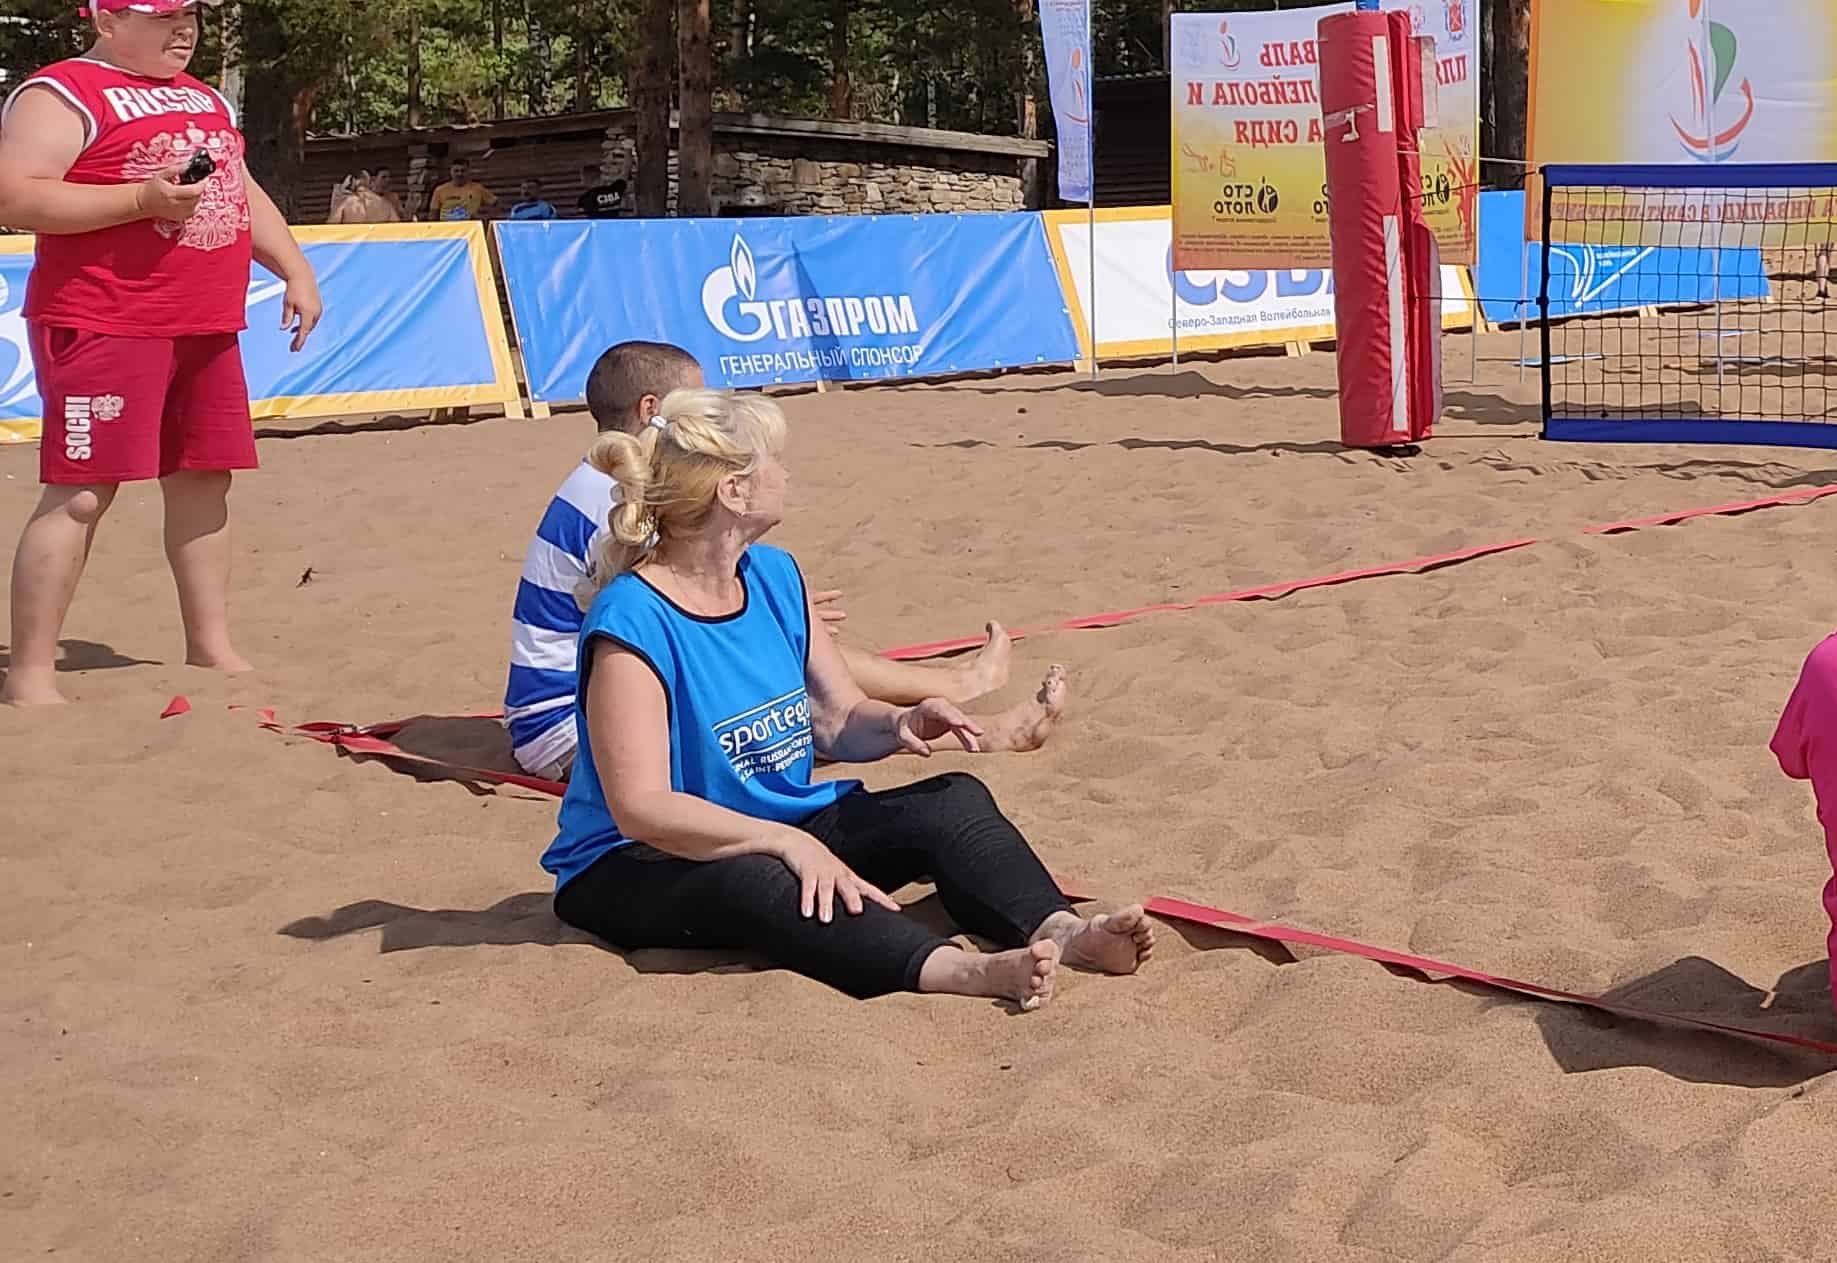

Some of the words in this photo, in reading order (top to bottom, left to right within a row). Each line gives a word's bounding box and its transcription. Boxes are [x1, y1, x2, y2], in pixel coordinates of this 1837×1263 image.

[770, 295, 919, 340] ГАЗПРОМ
[1168, 315, 1258, 330] Северо-Западная
[719, 345, 847, 376] ГЕНЕРАЛЬНЫЙ
[851, 343, 923, 367] СПОНСОР
[64, 396, 92, 460] SOCHI
